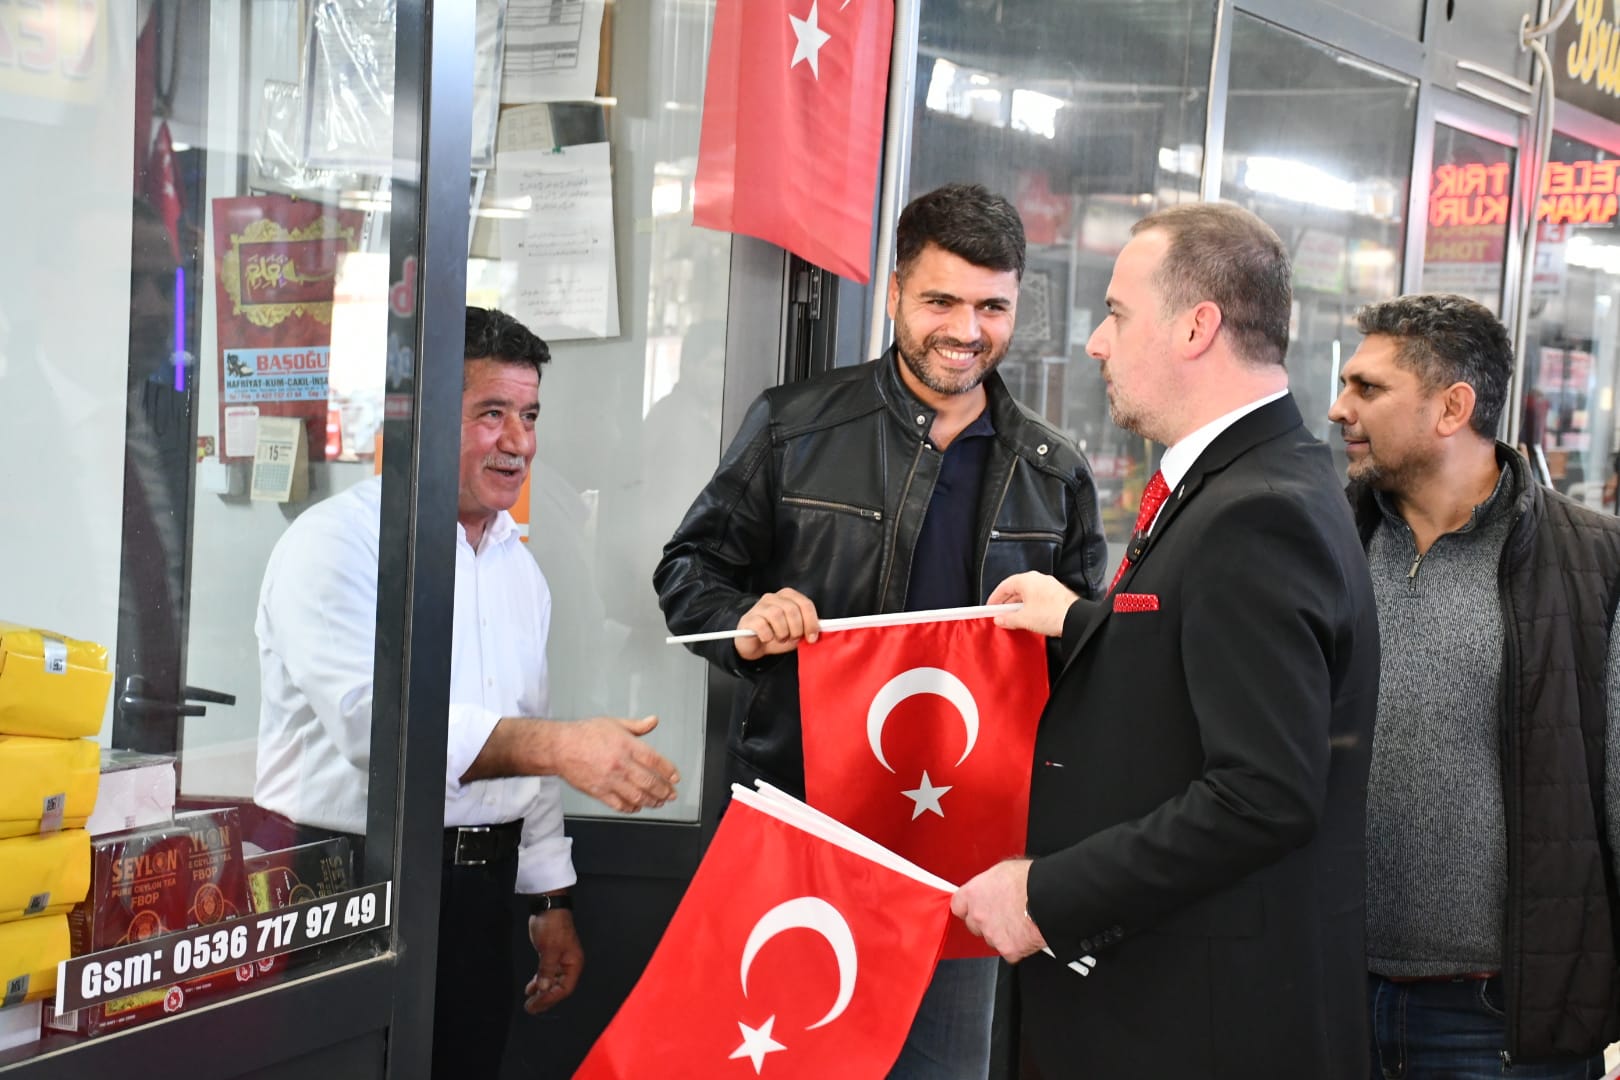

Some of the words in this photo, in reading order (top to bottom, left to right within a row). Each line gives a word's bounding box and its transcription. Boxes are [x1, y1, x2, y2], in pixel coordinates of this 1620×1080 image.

[256, 350, 330, 374] BAŞOĞU
[111, 850, 177, 882] SEYLON
[131, 891, 160, 909] FBOP
[81, 949, 163, 999] Gsm:
[173, 926, 248, 975] 0536
[256, 912, 299, 953] 717
[305, 901, 338, 939] 97
[344, 892, 376, 927] 49
